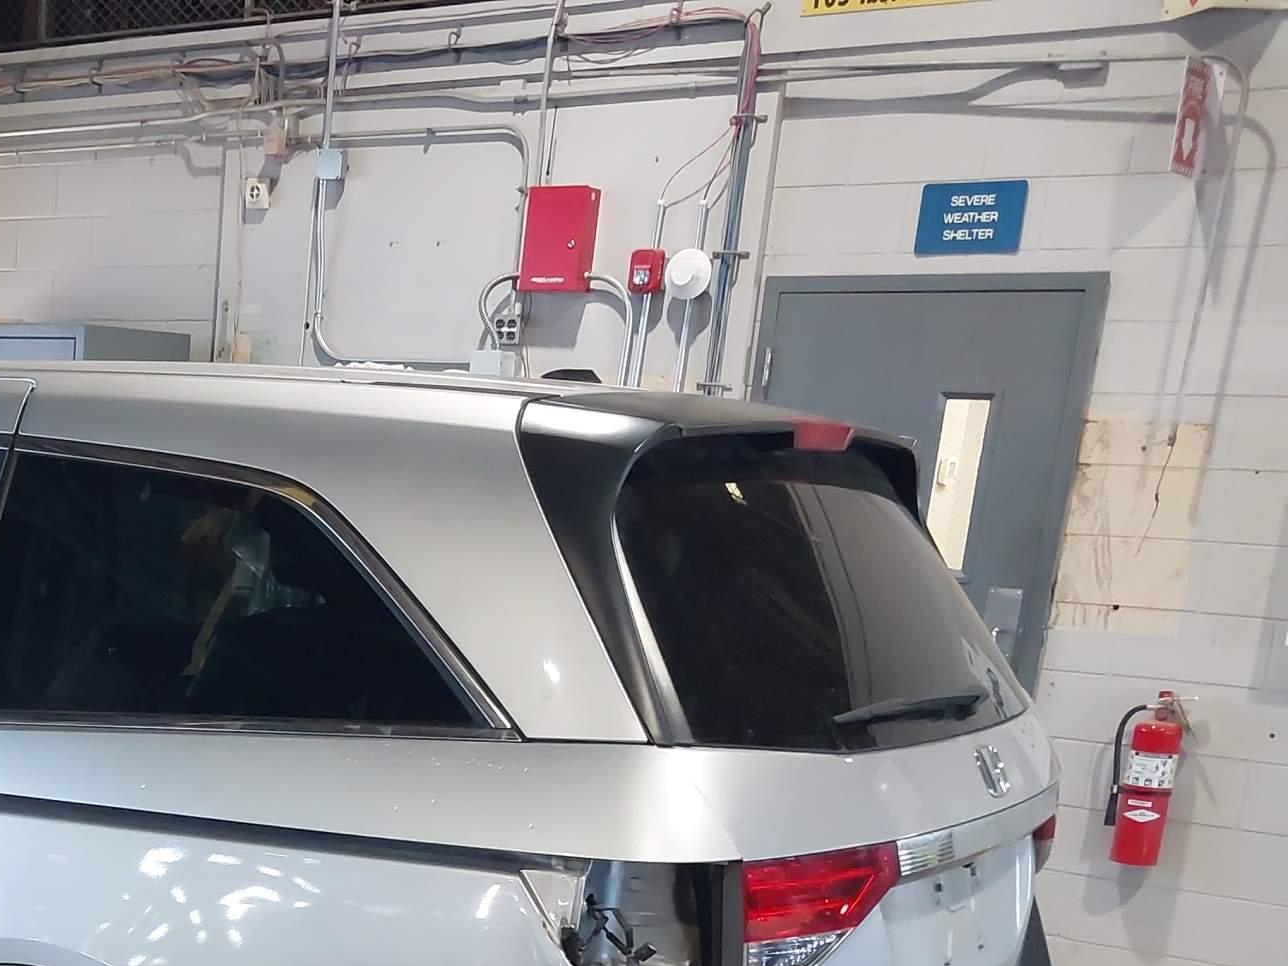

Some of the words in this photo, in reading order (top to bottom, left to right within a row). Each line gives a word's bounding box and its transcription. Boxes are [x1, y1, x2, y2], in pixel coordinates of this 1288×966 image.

[950, 194, 997, 207] SEVERE
[943, 211, 999, 224] WEATHER
[942, 229, 994, 241] SHELTER
